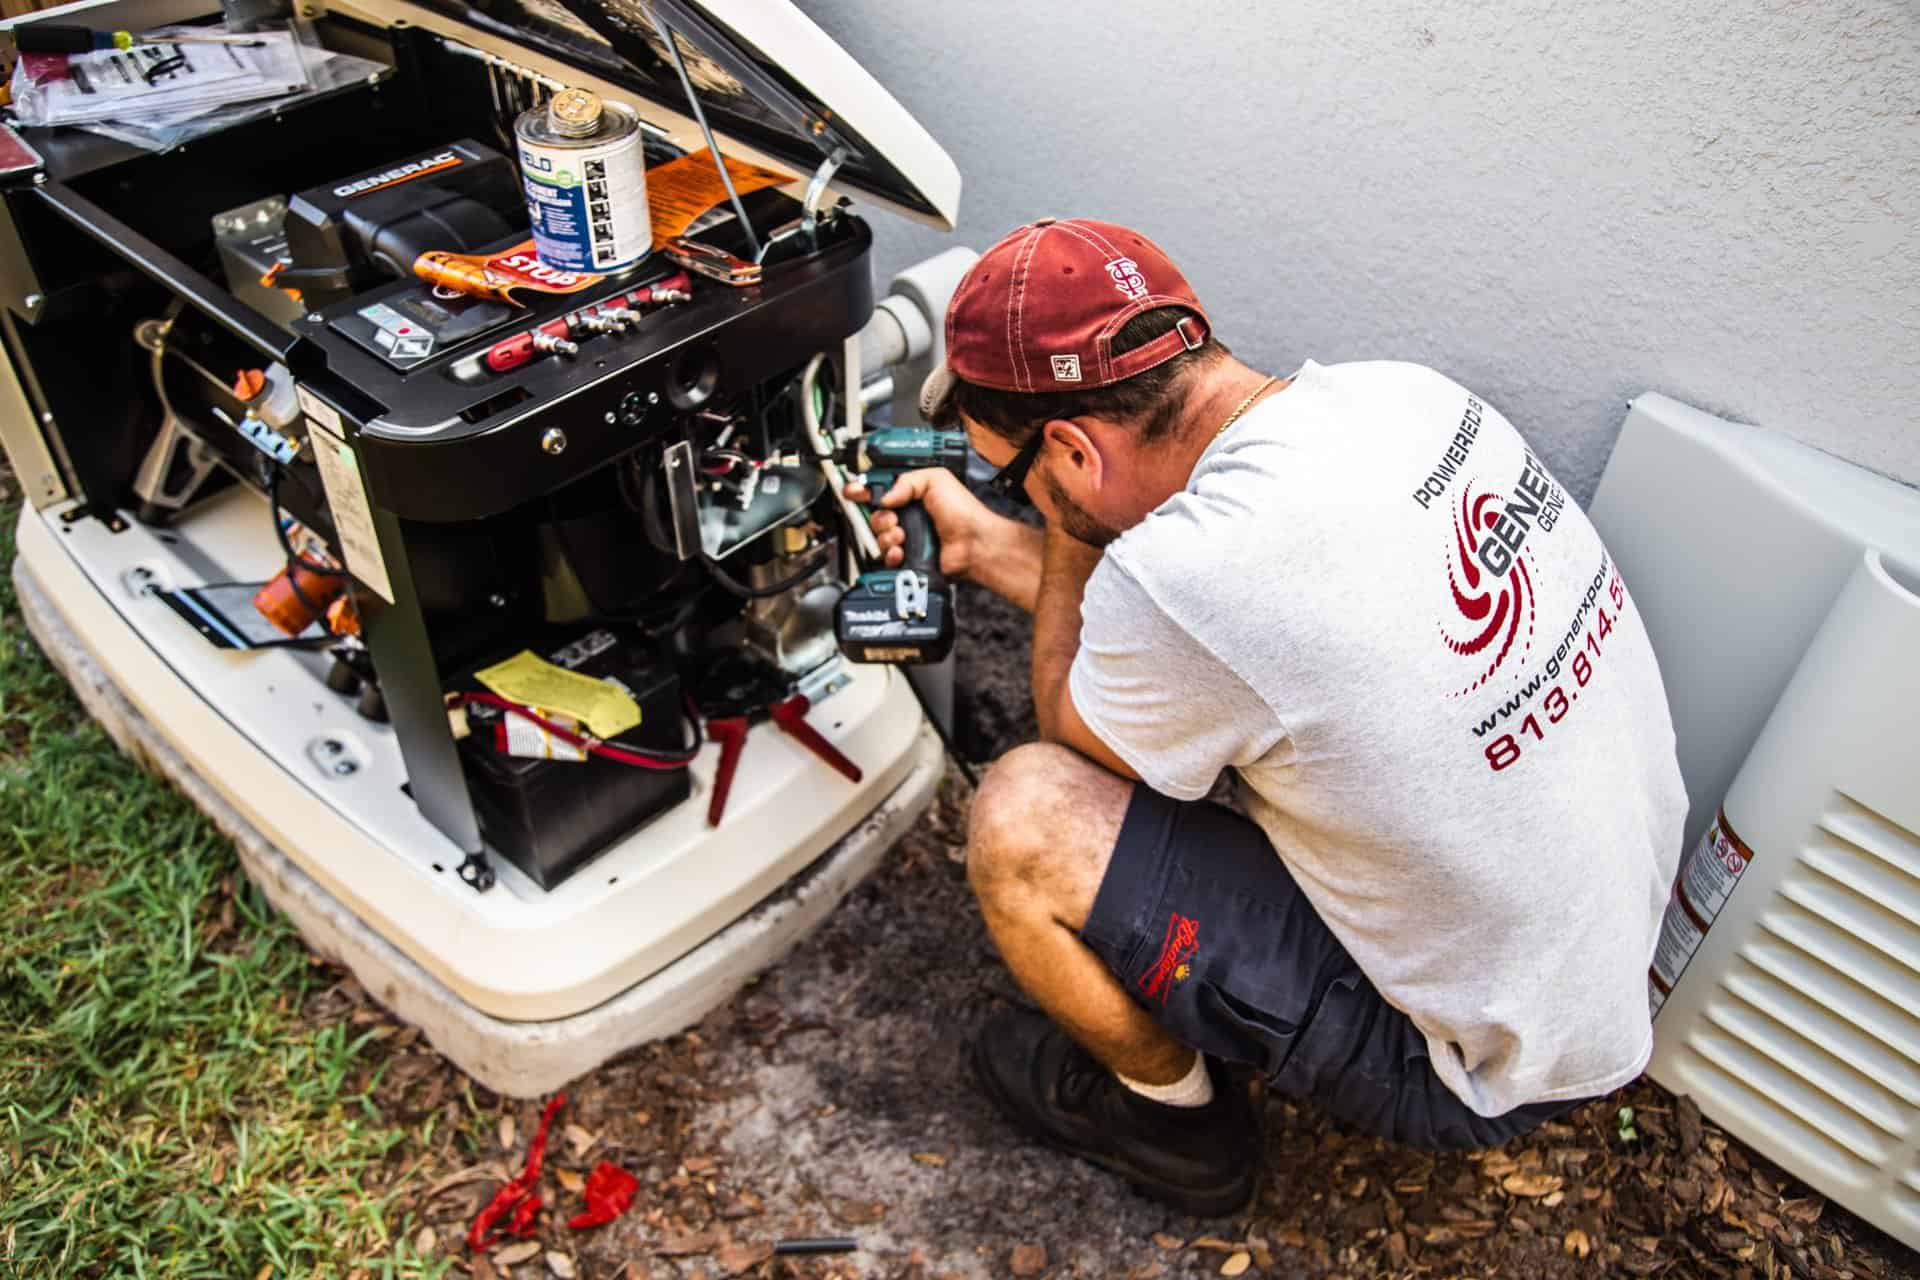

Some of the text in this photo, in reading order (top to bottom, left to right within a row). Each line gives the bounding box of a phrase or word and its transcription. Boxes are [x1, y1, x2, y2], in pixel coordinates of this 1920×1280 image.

[333, 151, 455, 196] GENERAC
[1412, 394, 1482, 509] POWERED B
[1478, 447, 1550, 577] GENER
[1537, 484, 1565, 532] GENE
[1472, 552, 1607, 737] www.generxpow
[1484, 566, 1623, 771] 813.814.5
